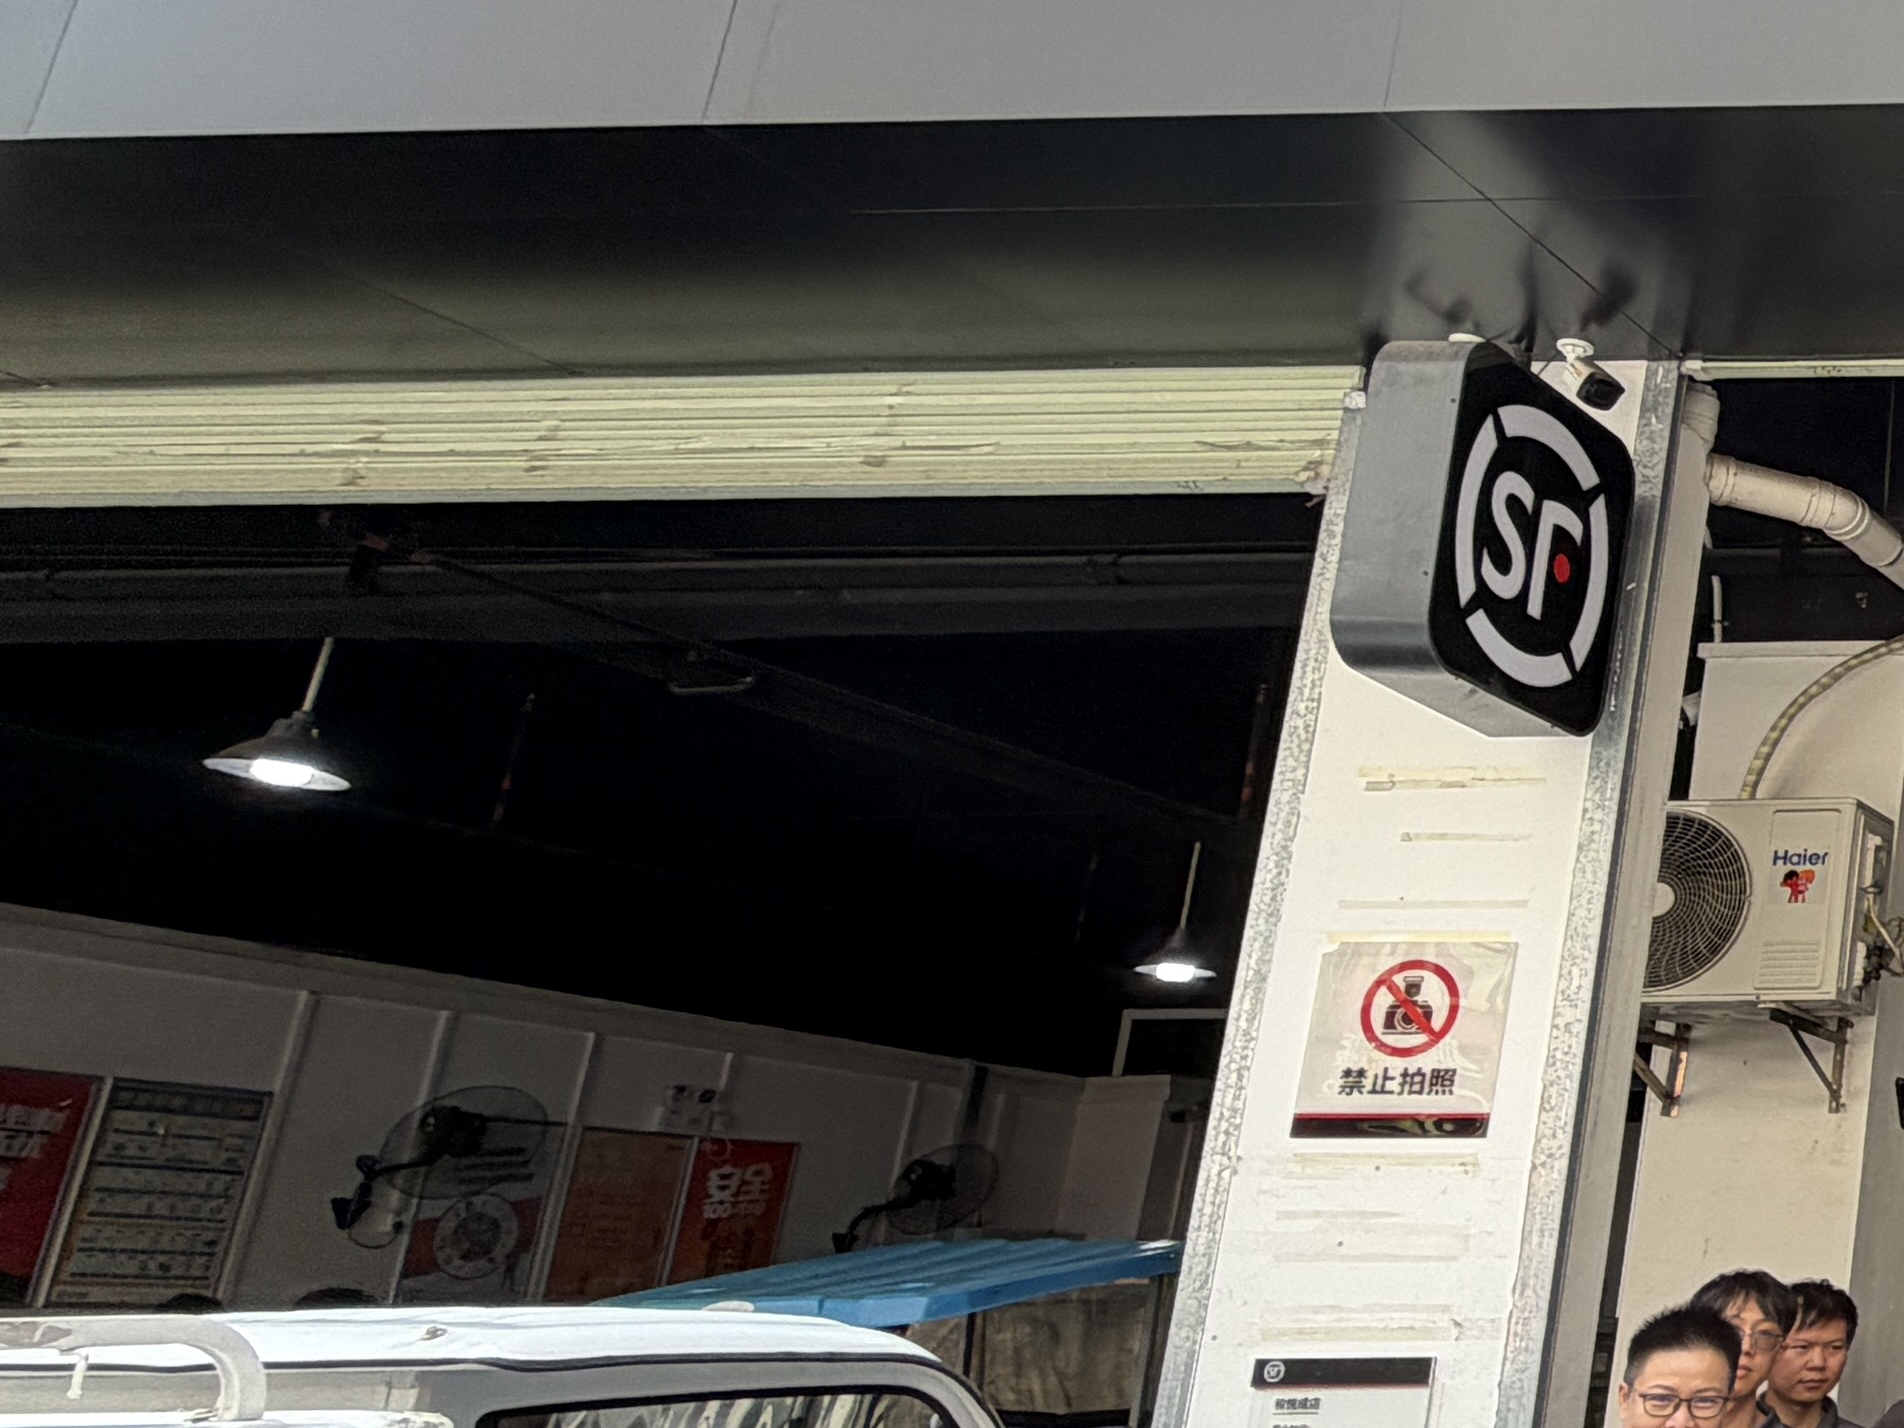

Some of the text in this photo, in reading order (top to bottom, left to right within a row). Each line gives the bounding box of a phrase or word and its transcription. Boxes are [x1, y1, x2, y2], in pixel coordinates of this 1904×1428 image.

[1772, 849, 1829, 869] Haier
[1337, 1066, 1457, 1098] 禁止拍照
